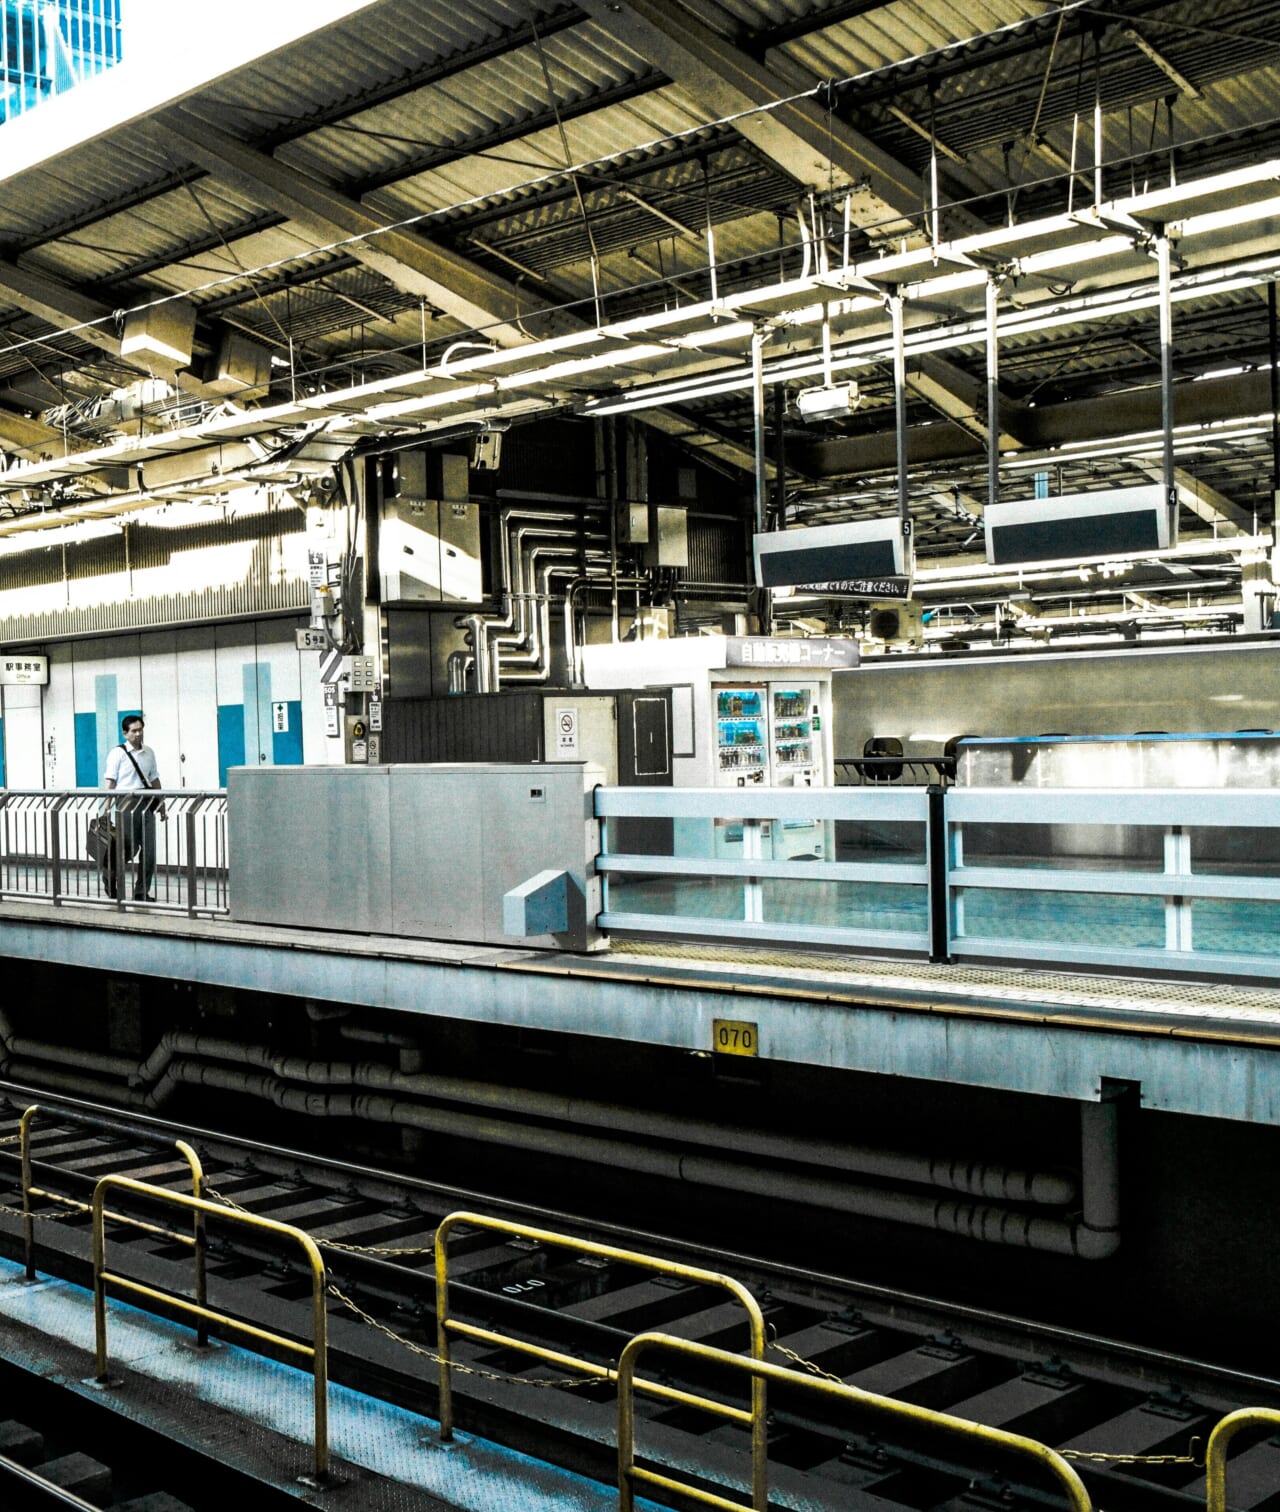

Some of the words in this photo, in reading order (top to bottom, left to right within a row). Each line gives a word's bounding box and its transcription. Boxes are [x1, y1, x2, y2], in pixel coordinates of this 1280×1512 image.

[1169, 490, 1176, 504] 4
[903, 522, 910, 535] 5
[305, 633, 325, 646] 5号車
[5, 662, 41, 672] 駅事務室
[719, 1027, 751, 1048] 070
[502, 1279, 546, 1294] 070
